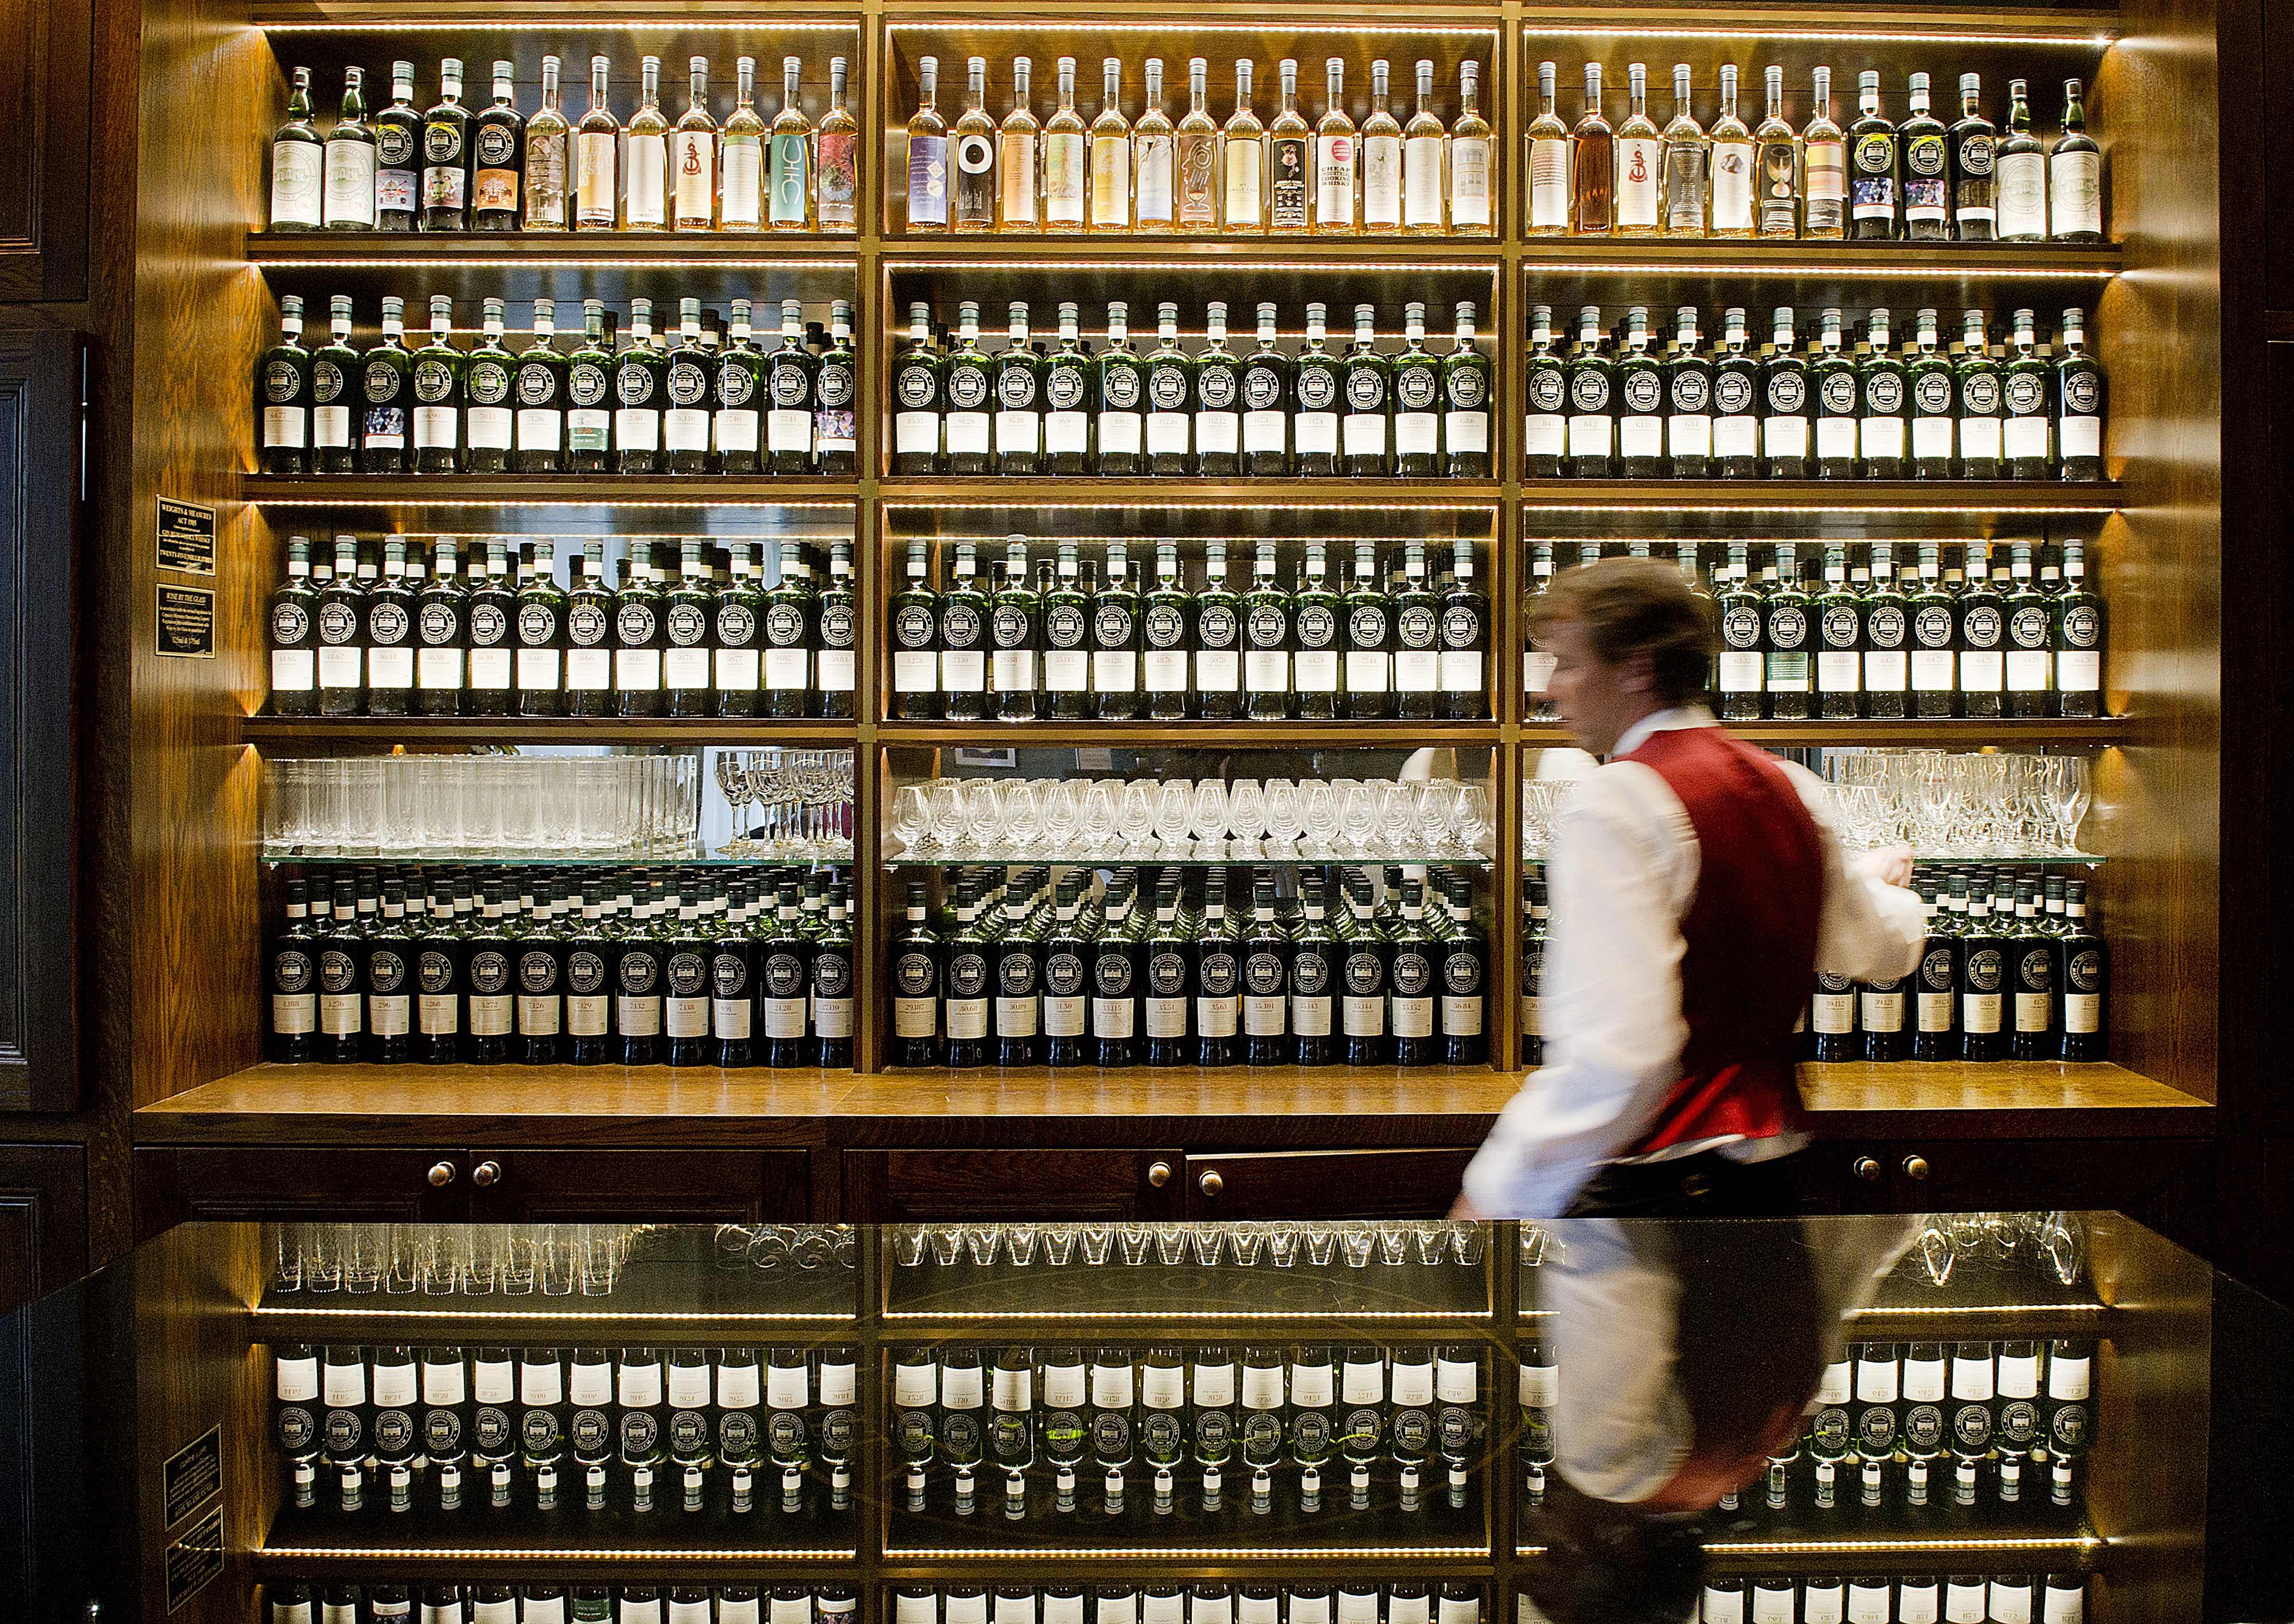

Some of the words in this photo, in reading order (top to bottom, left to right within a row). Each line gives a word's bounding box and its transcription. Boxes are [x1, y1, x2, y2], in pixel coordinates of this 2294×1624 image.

[500, 143, 512, 159] SOCIETY
[1410, 369, 1430, 378] SCOTCH
[909, 368, 929, 378] SCOTCH
[922, 385, 933, 403] SOCIETY
[1423, 385, 1434, 402] SOCIETY
[1405, 397, 1423, 405] WHISKY
[907, 608, 928, 617] SCOTCH
[1362, 609, 1382, 618] SCOTCH
[1735, 609, 1755, 618] SCOTCH
[921, 624, 932, 643] SOCIETY
[1375, 624, 1384, 642] SOCIETY
[1749, 624, 1759, 642] SOCIETY
[902, 637, 920, 645] WHISKY
[1356, 637, 1374, 645] WHISKY
[1730, 637, 1748, 645] WHISKY
[631, 954, 651, 962] SCOTCH
[1214, 955, 1232, 963] SCOTCH
[1056, 956, 1078, 964] SCOTCH
[1071, 971, 1081, 989] SOCIETY
[644, 969, 655, 987] SOCIETY
[1227, 970, 1236, 988] SOCIETY
[625, 982, 642, 990] WHISKY
[1208, 983, 1225, 991] WHISKY
